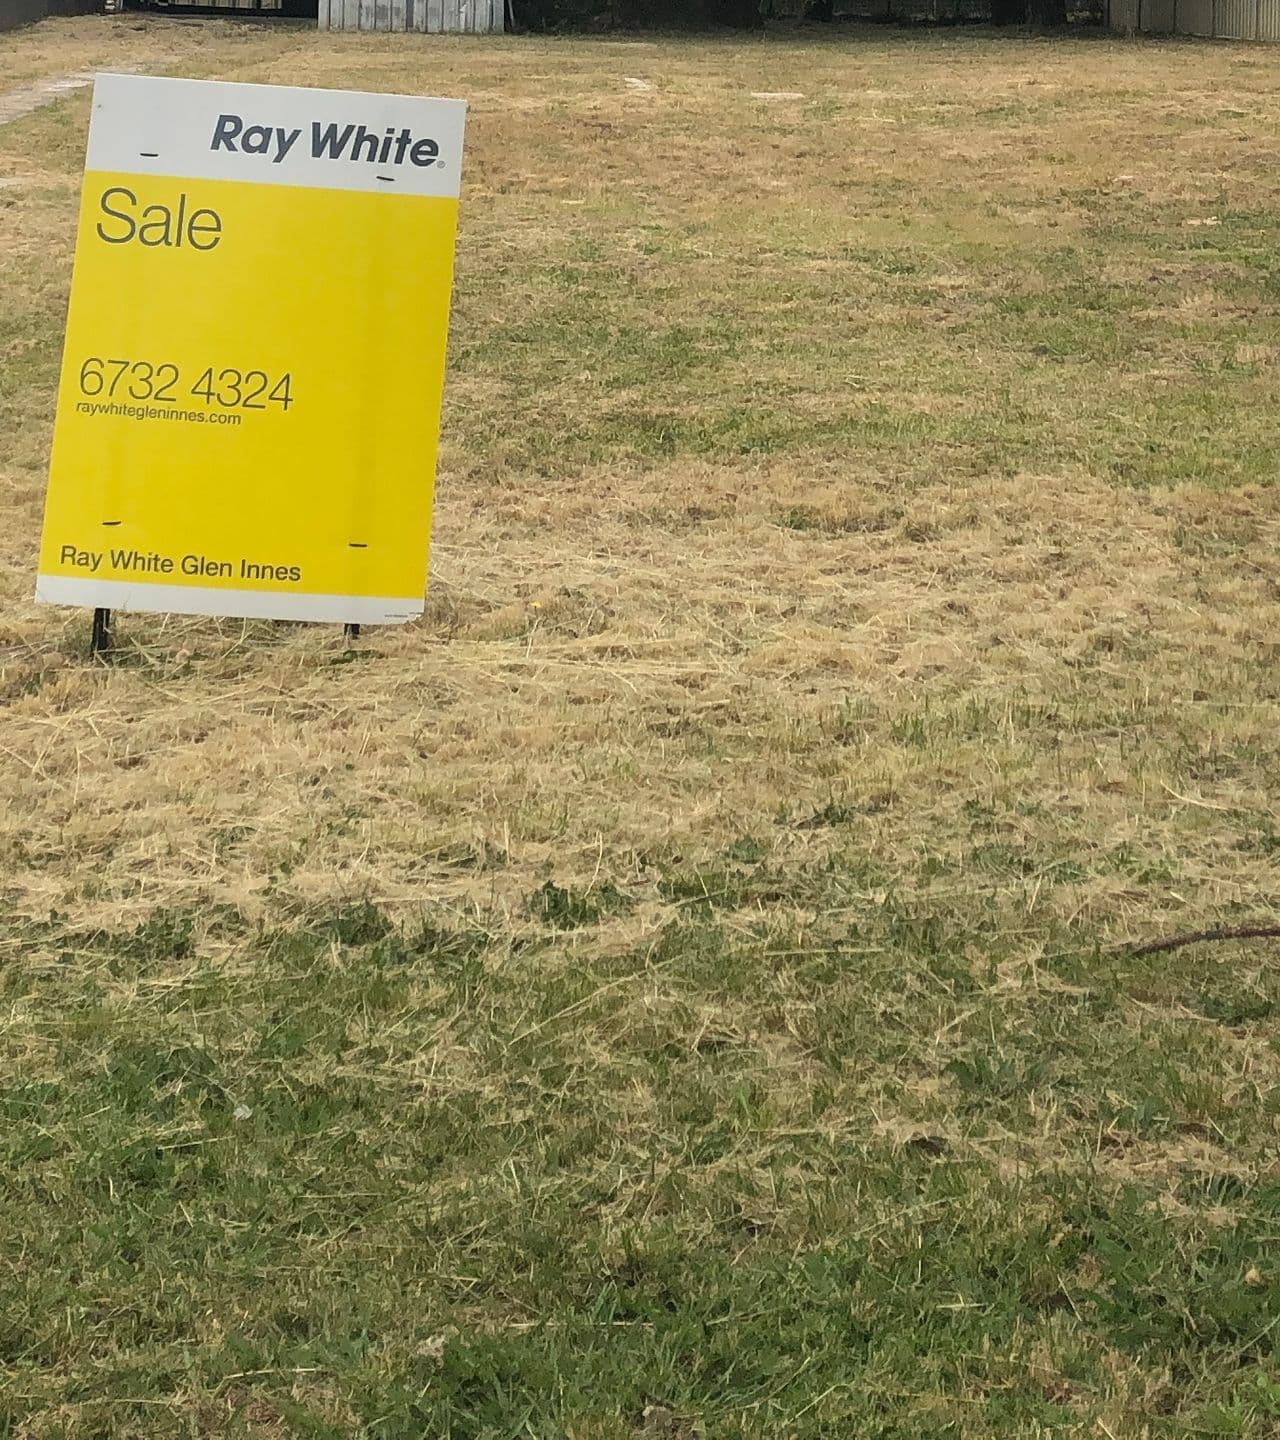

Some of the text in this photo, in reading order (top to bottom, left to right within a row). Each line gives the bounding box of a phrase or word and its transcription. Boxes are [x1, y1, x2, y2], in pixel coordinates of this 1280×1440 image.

[210, 114, 301, 163] Ray
[96, 187, 222, 250] Sale
[79, 357, 293, 411] 6732 4324
[76, 401, 241, 426] raywhitegleninnes.com
[60, 545, 301, 582] Ray White Glen Innes
